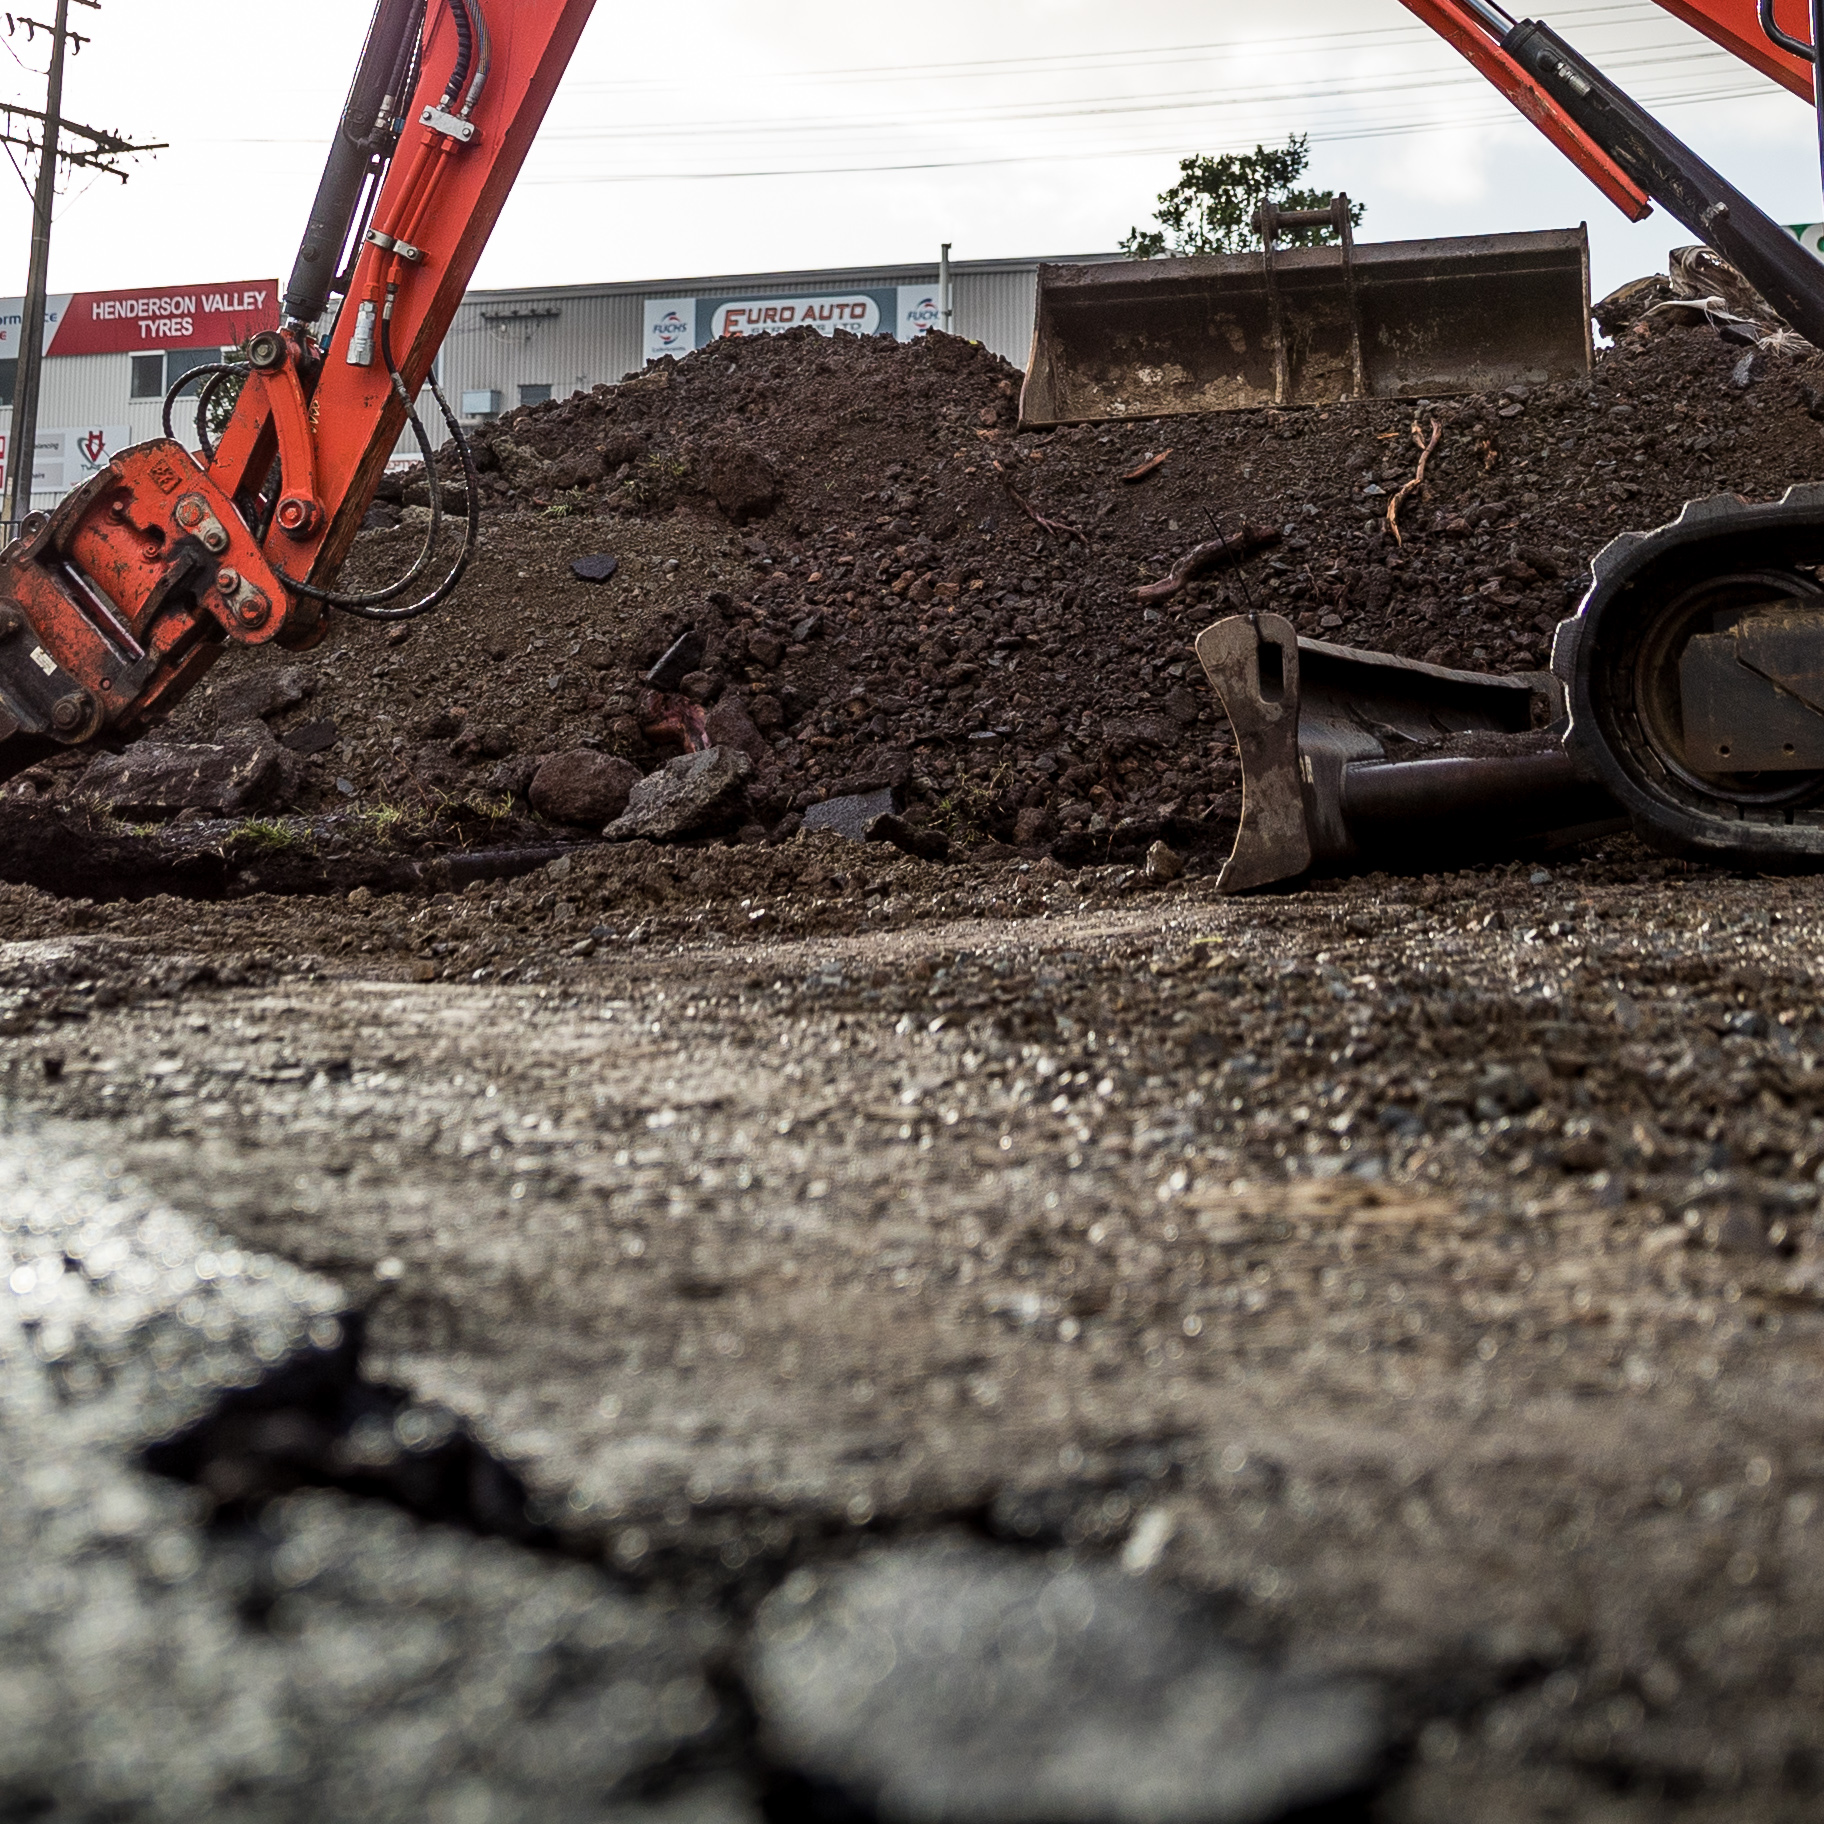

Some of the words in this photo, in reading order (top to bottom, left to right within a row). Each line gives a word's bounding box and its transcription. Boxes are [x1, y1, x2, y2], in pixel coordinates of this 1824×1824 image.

[92, 295, 196, 320] HENDERSON
[201, 291, 266, 312] VALLEY
[724, 306, 795, 337] EURO
[801, 302, 867, 322] AUTO
[907, 311, 939, 321] FUCH
[138, 318, 193, 338] TYRES
[653, 323, 687, 334] FUCHS
